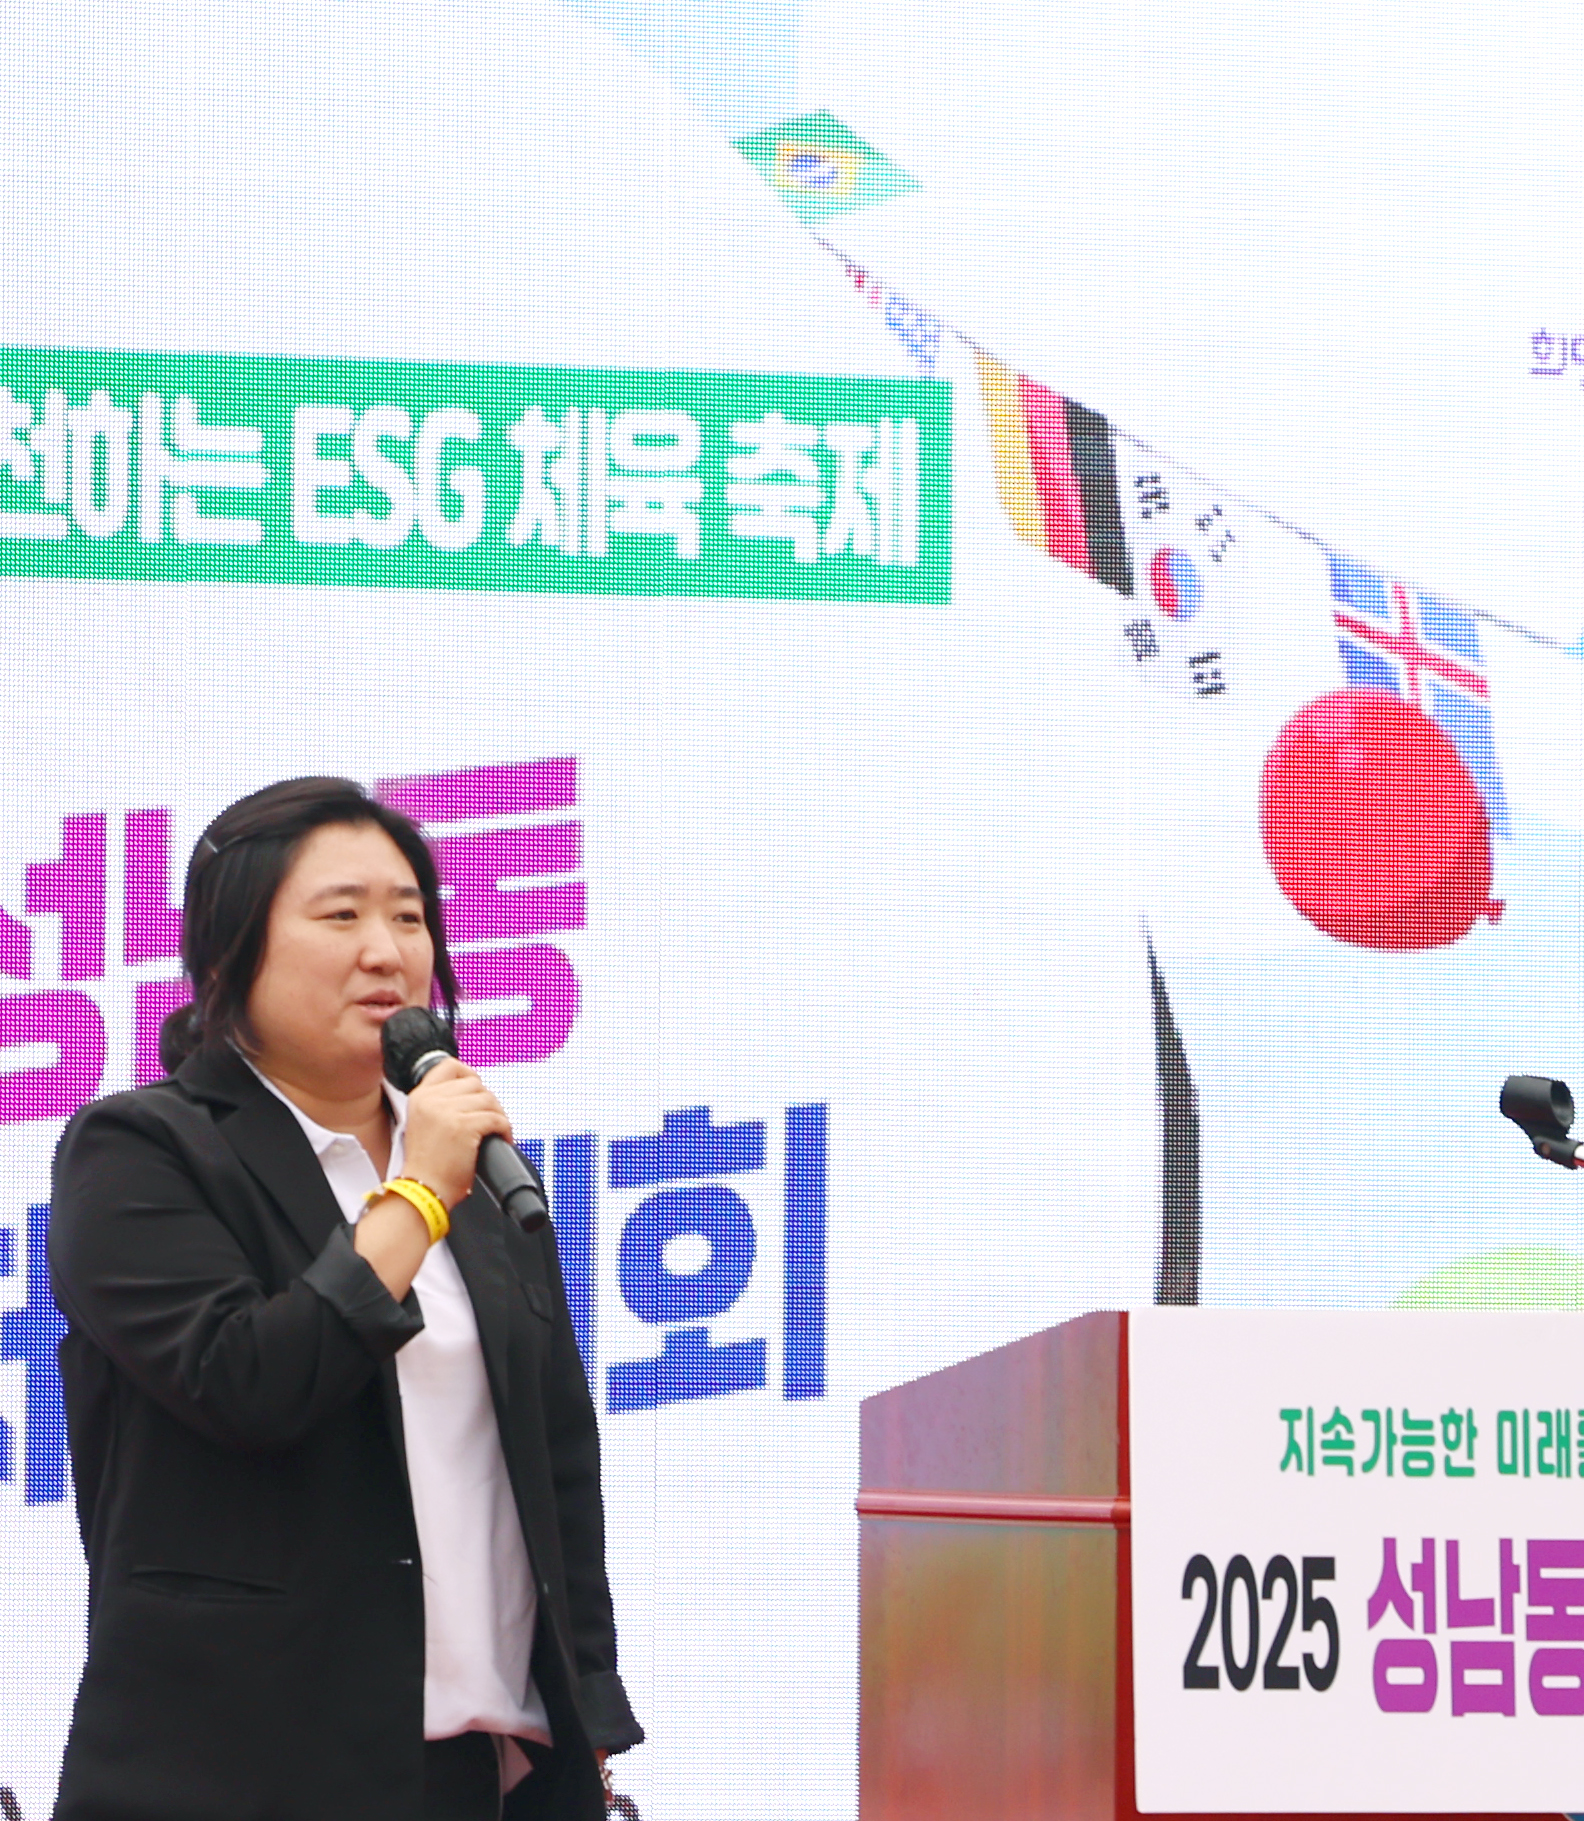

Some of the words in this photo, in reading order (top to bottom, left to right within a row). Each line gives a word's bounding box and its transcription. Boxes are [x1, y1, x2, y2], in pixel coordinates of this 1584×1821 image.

[288, 400, 489, 554] ESG
[502, 403, 706, 563] 체육
[722, 409, 924, 569] 축제
[1278, 1406, 1479, 1479] 지속가능한
[1180, 1552, 1342, 1693] 2025
